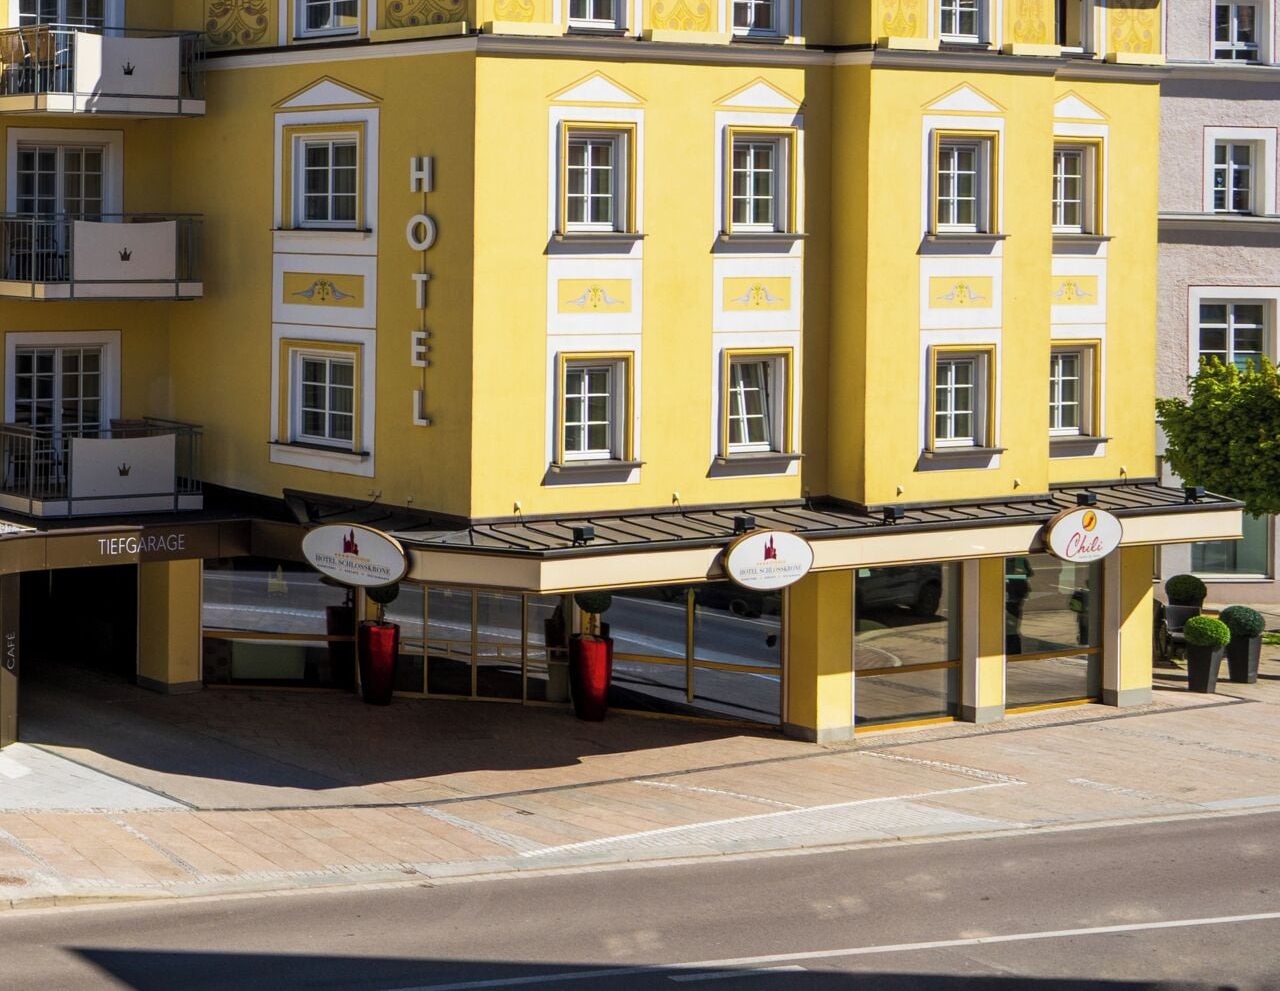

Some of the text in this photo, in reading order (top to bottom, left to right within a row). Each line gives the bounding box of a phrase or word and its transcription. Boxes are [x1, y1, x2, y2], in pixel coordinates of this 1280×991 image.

[406, 155, 437, 427] HOTEL
[98, 534, 185, 555] TIEFGARAGE
[1066, 532, 1103, 558] Chili
